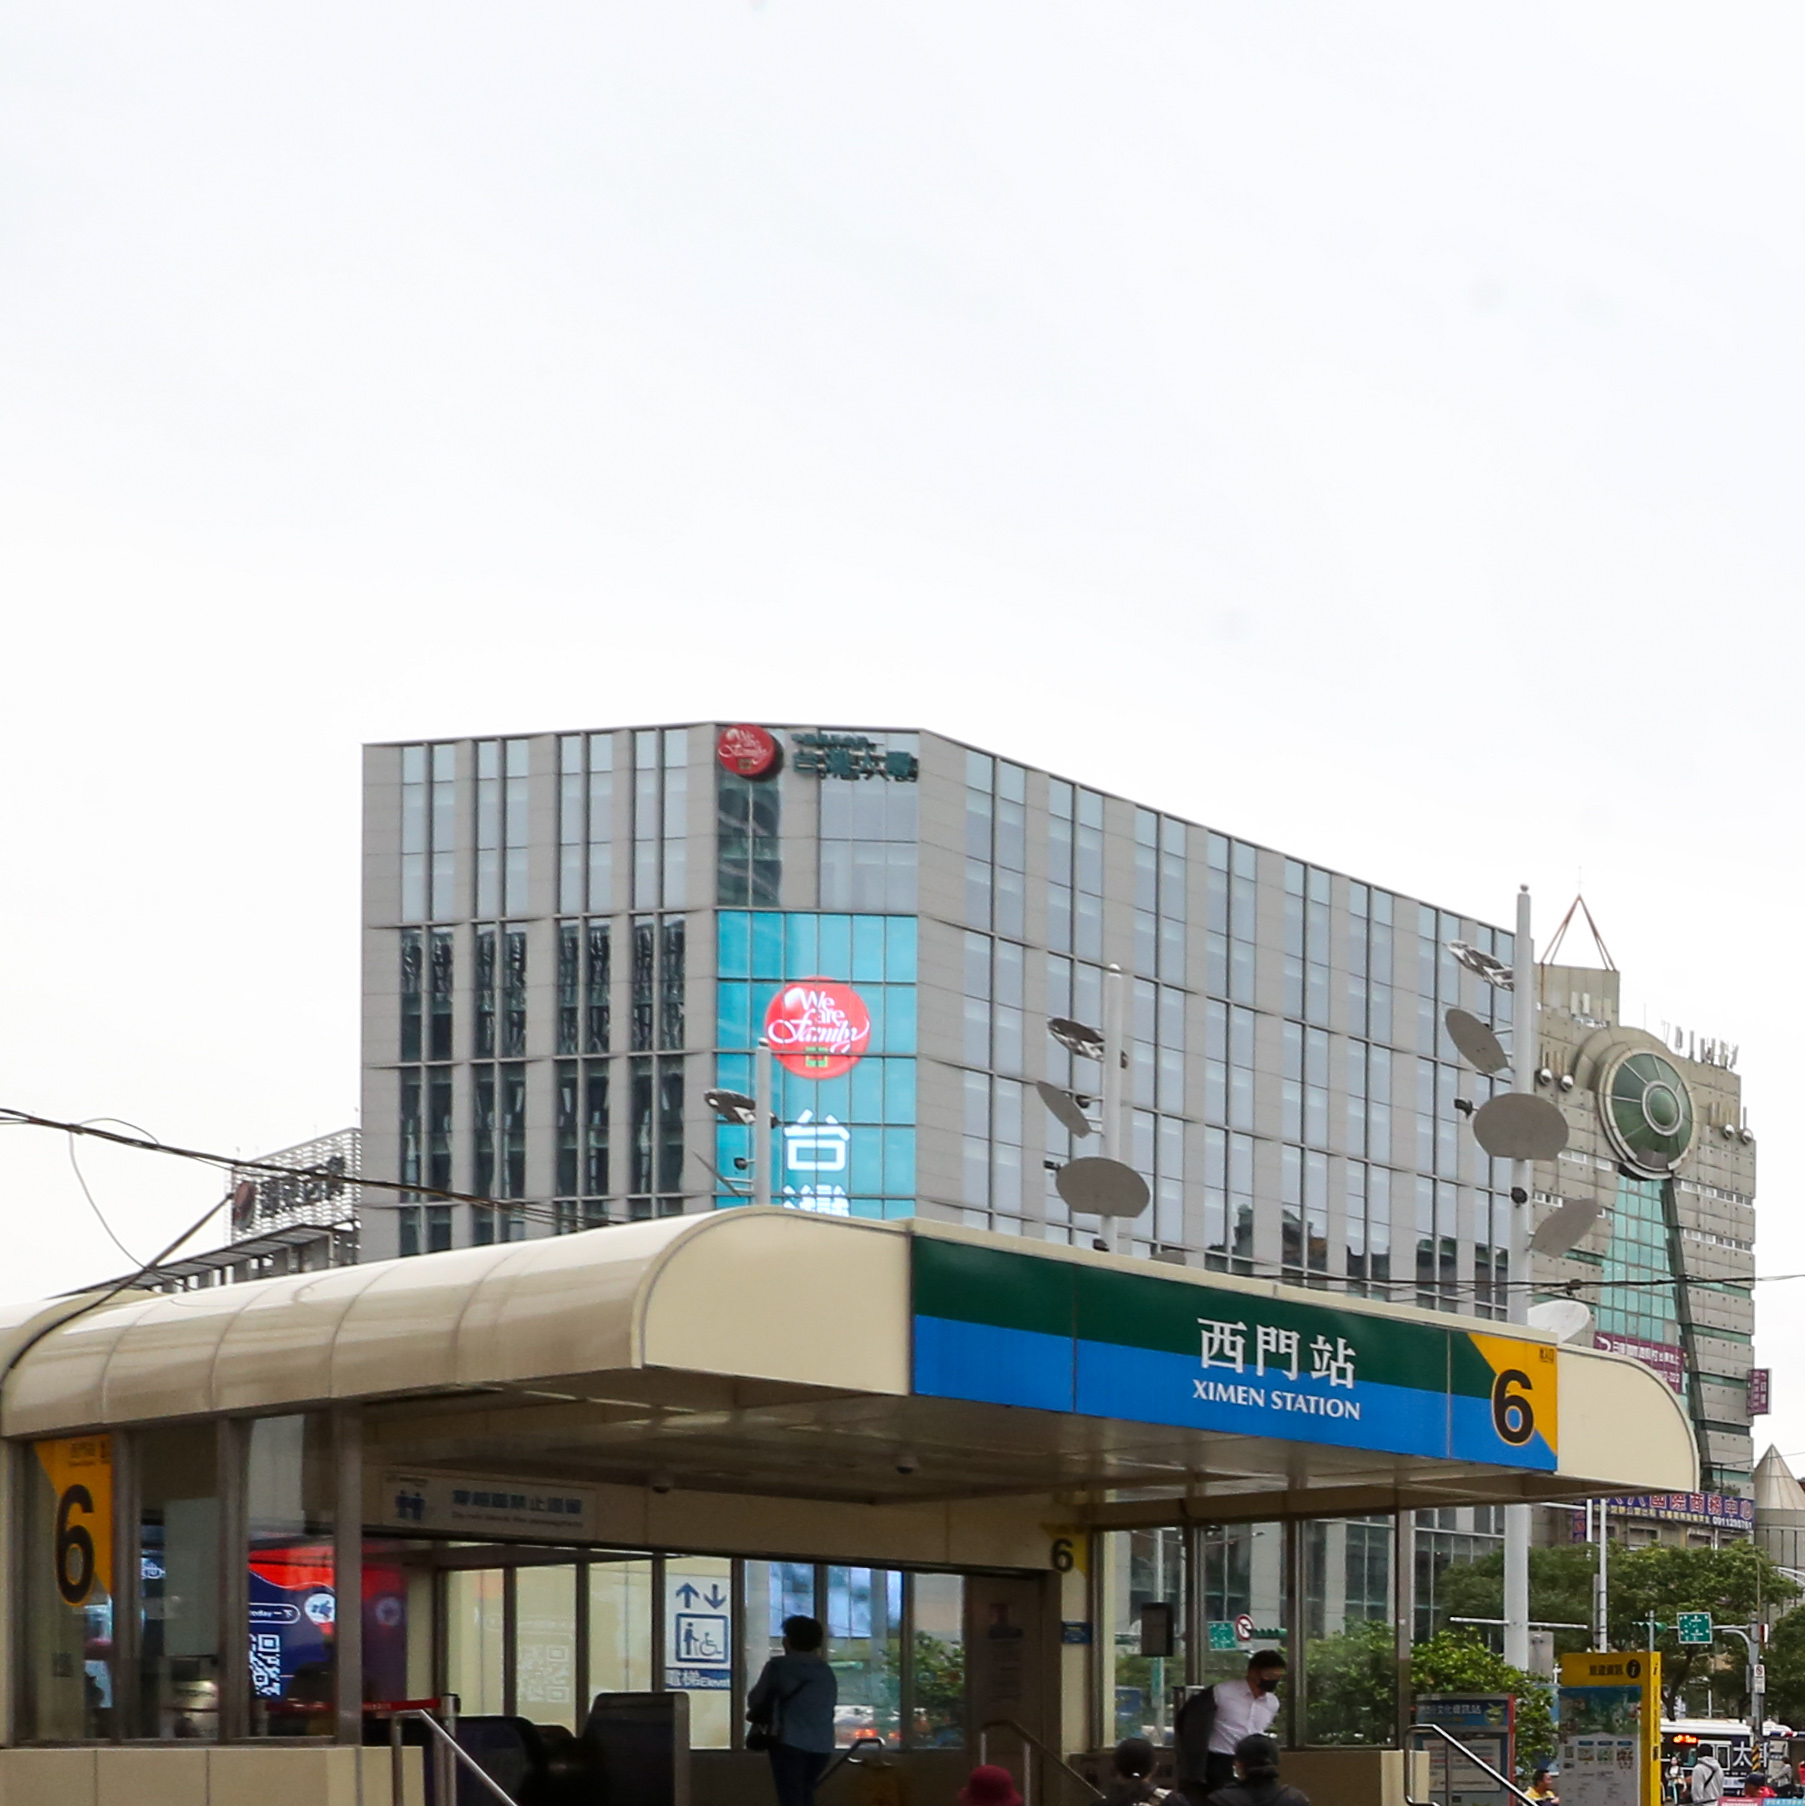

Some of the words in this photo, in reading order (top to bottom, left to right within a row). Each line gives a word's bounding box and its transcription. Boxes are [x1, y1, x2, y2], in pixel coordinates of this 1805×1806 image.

[1196, 1317, 1357, 1390] 西門站
[1192, 1379, 1266, 1408] XIMEN
[1270, 1390, 1361, 1421] STATION
[1491, 1368, 1535, 1447] 6
[55, 1483, 95, 1606] 6
[1050, 1537, 1075, 1574] 6
[665, 1668, 700, 1688] 電梯
